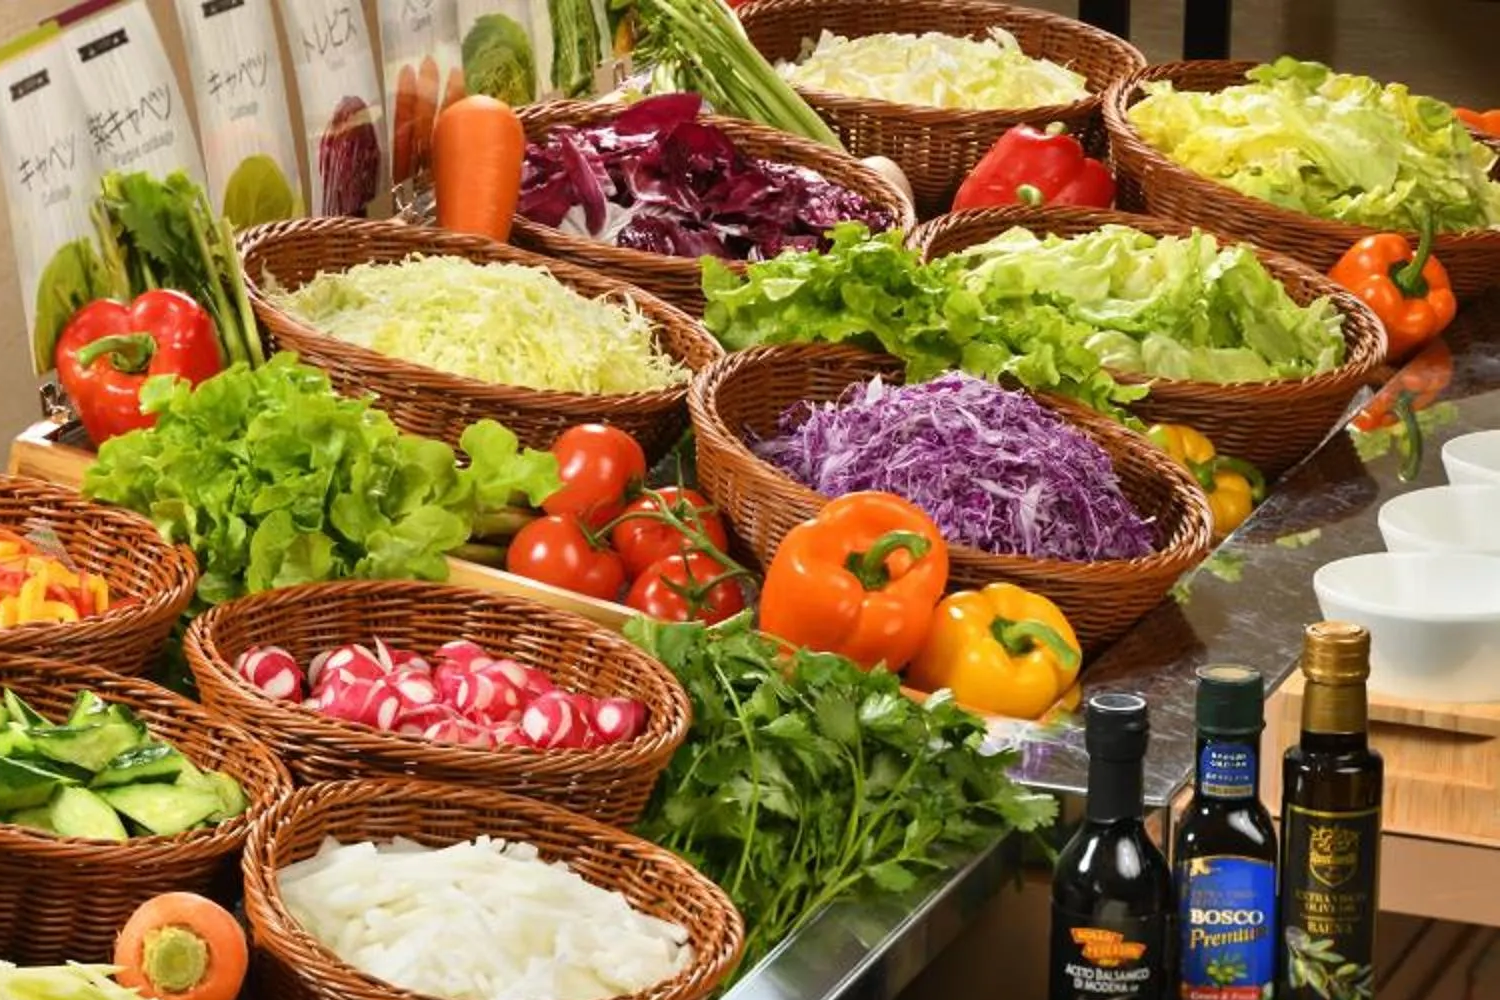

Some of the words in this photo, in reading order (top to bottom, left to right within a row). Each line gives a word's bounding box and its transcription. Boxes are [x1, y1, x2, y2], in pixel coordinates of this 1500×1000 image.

[208, 53, 268, 102] キャベツ
[88, 83, 171, 154] 紫キャベツ
[19, 133, 75, 192] キャベツ
[1190, 908, 1264, 926] BOSCO
